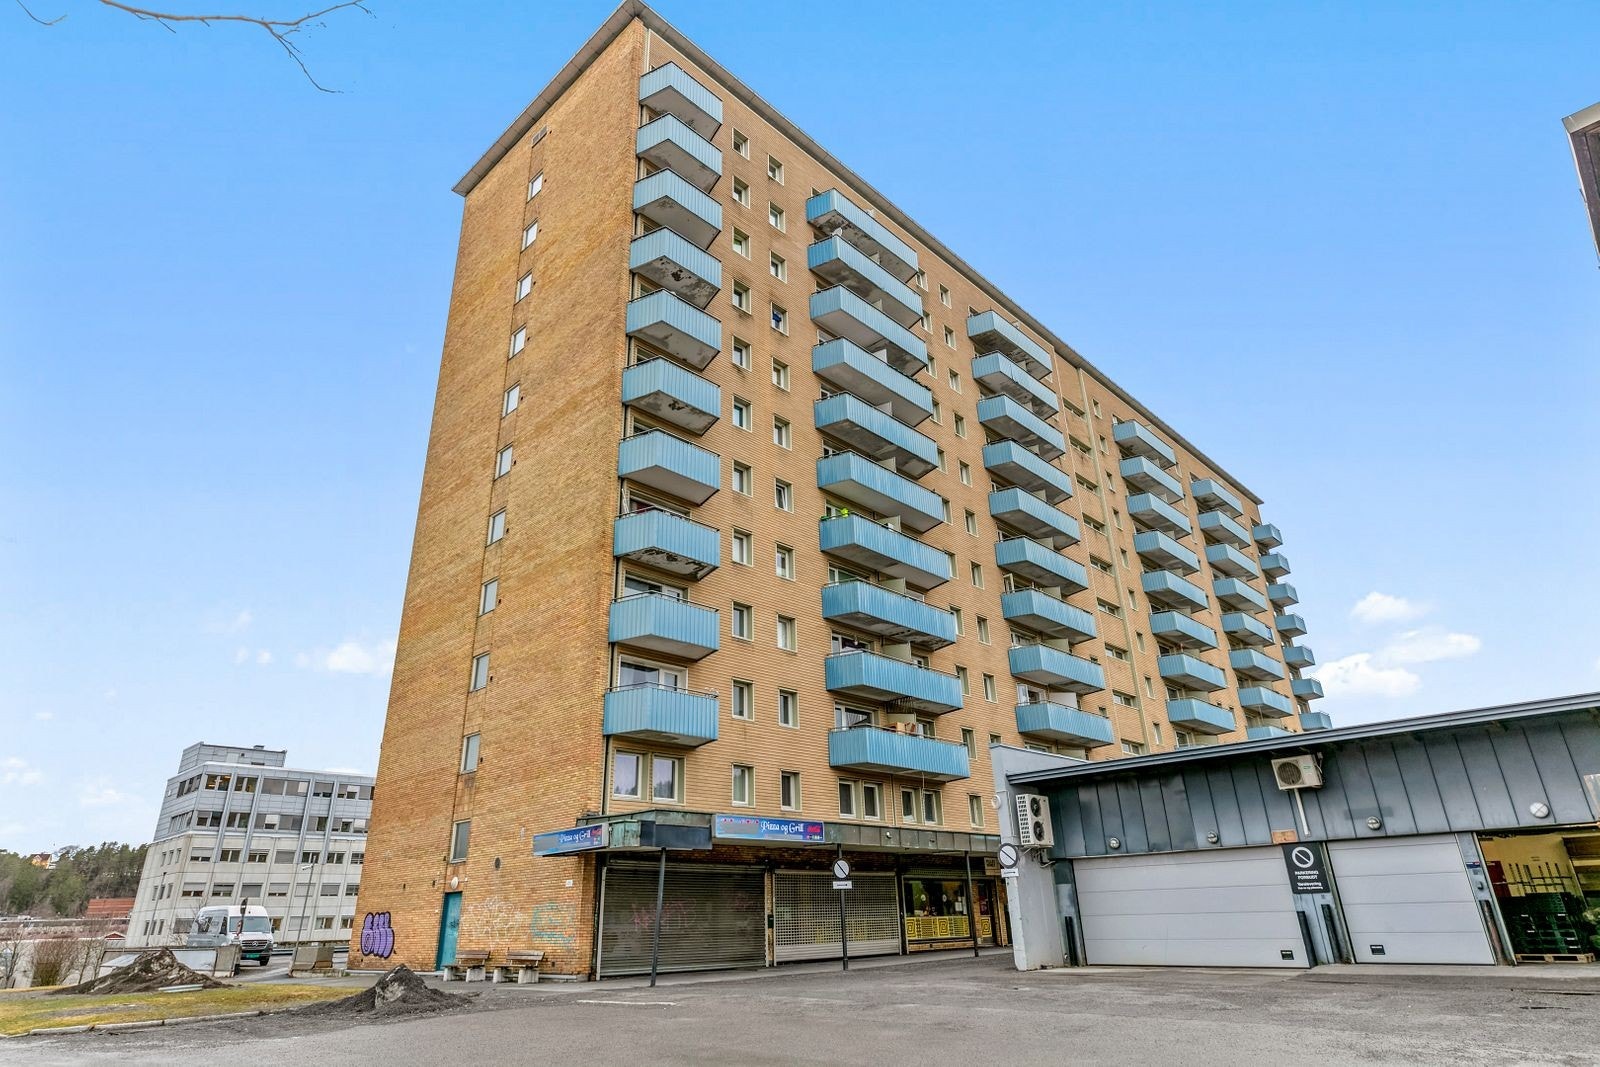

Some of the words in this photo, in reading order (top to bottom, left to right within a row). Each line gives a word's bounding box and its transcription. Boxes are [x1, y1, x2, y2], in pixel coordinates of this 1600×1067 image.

[760, 821, 780, 832] Pizza
[780, 825, 789, 835] og
[788, 822, 804, 833] Grill
